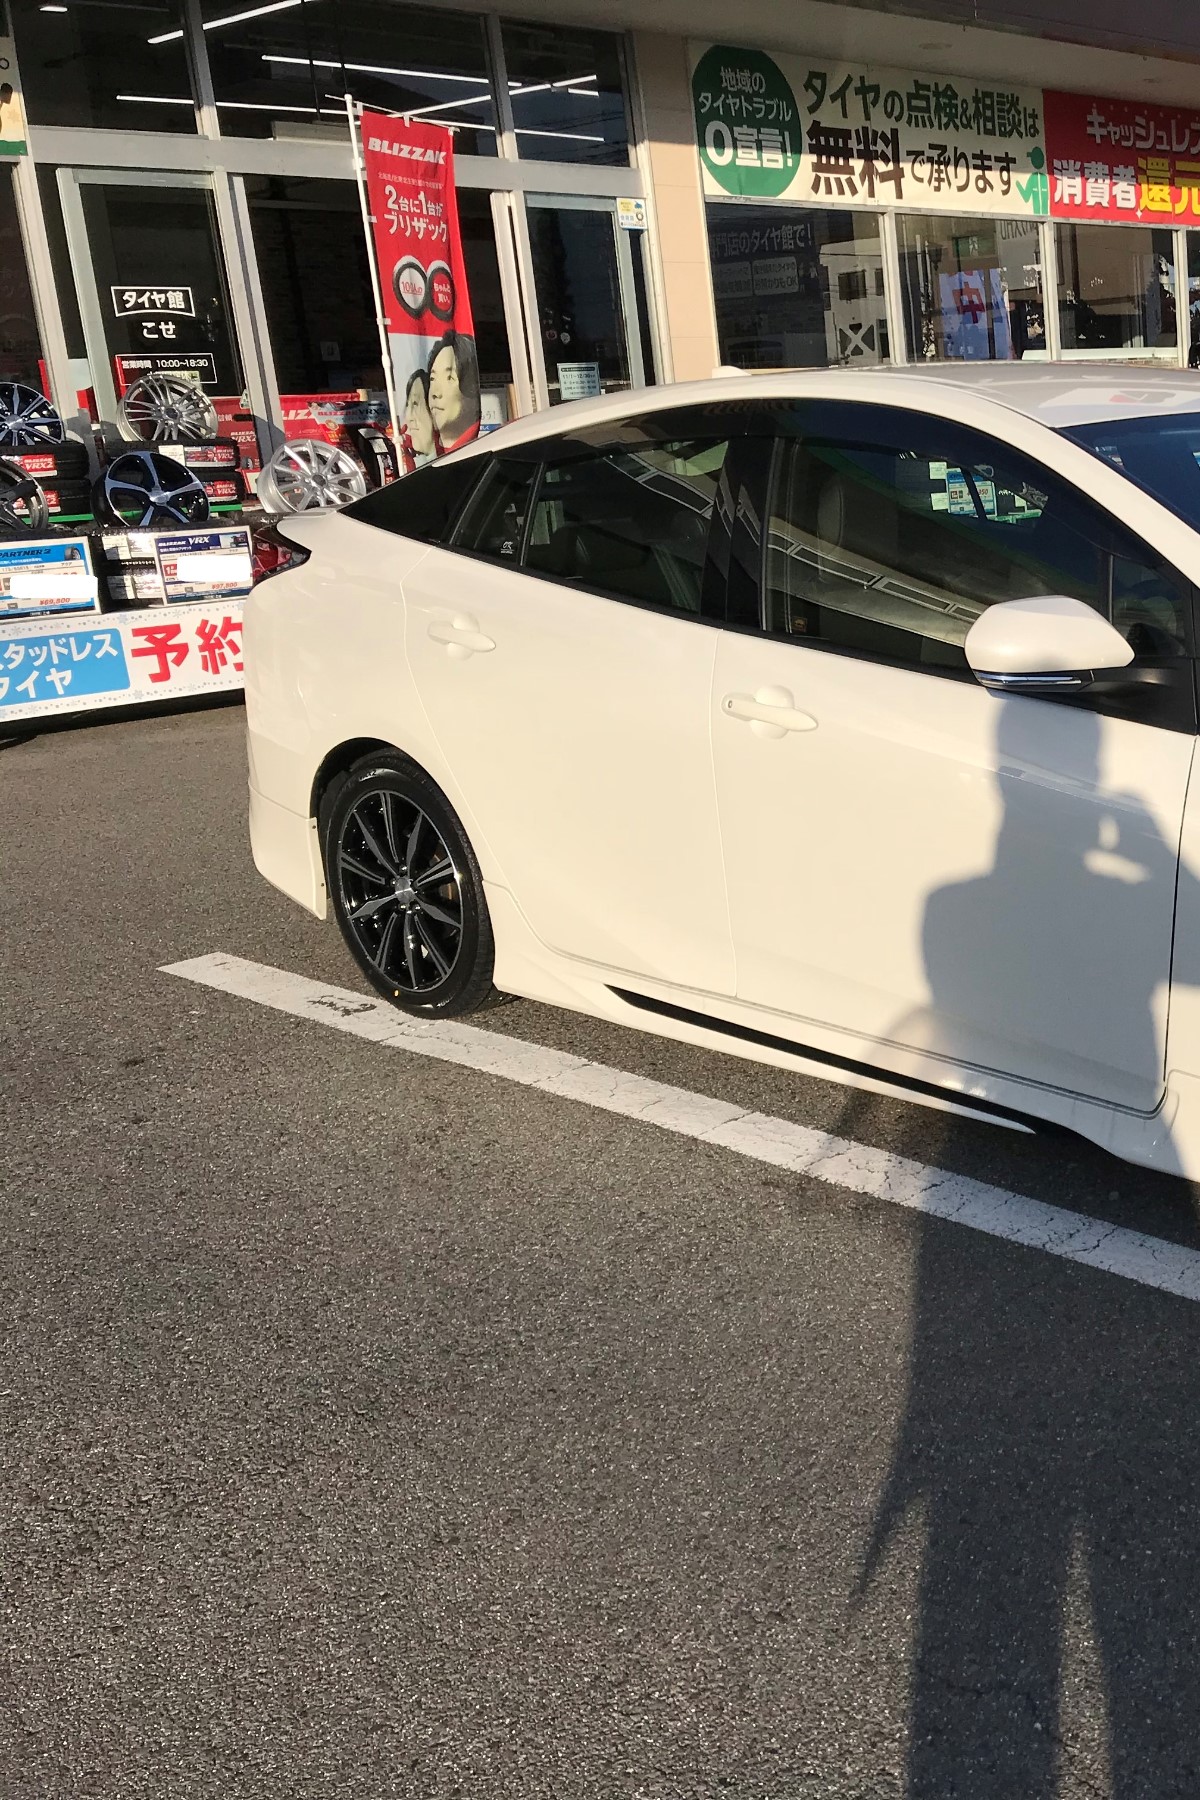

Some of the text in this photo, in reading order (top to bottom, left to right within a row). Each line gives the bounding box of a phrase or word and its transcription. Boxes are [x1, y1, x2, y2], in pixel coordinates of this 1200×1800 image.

[719, 66, 767, 94] 地域の
[698, 92, 792, 122] タイヤトラブル
[802, 70, 1040, 139] タイヤの点検&相談は
[367, 136, 448, 165] BLIZZAK
[805, 119, 1018, 200] 無料で承ります
[384, 184, 444, 216] 2台に1台が
[383, 211, 448, 243] ブリザック
[122, 290, 186, 309] タイヤ館
[141, 321, 177, 339] こせ
[121, 360, 152, 369] 営業時間
[25, 461, 54, 470] VRX2
[0, 548, 43, 557] PARTNER
[188, 535, 211, 545] VRX
